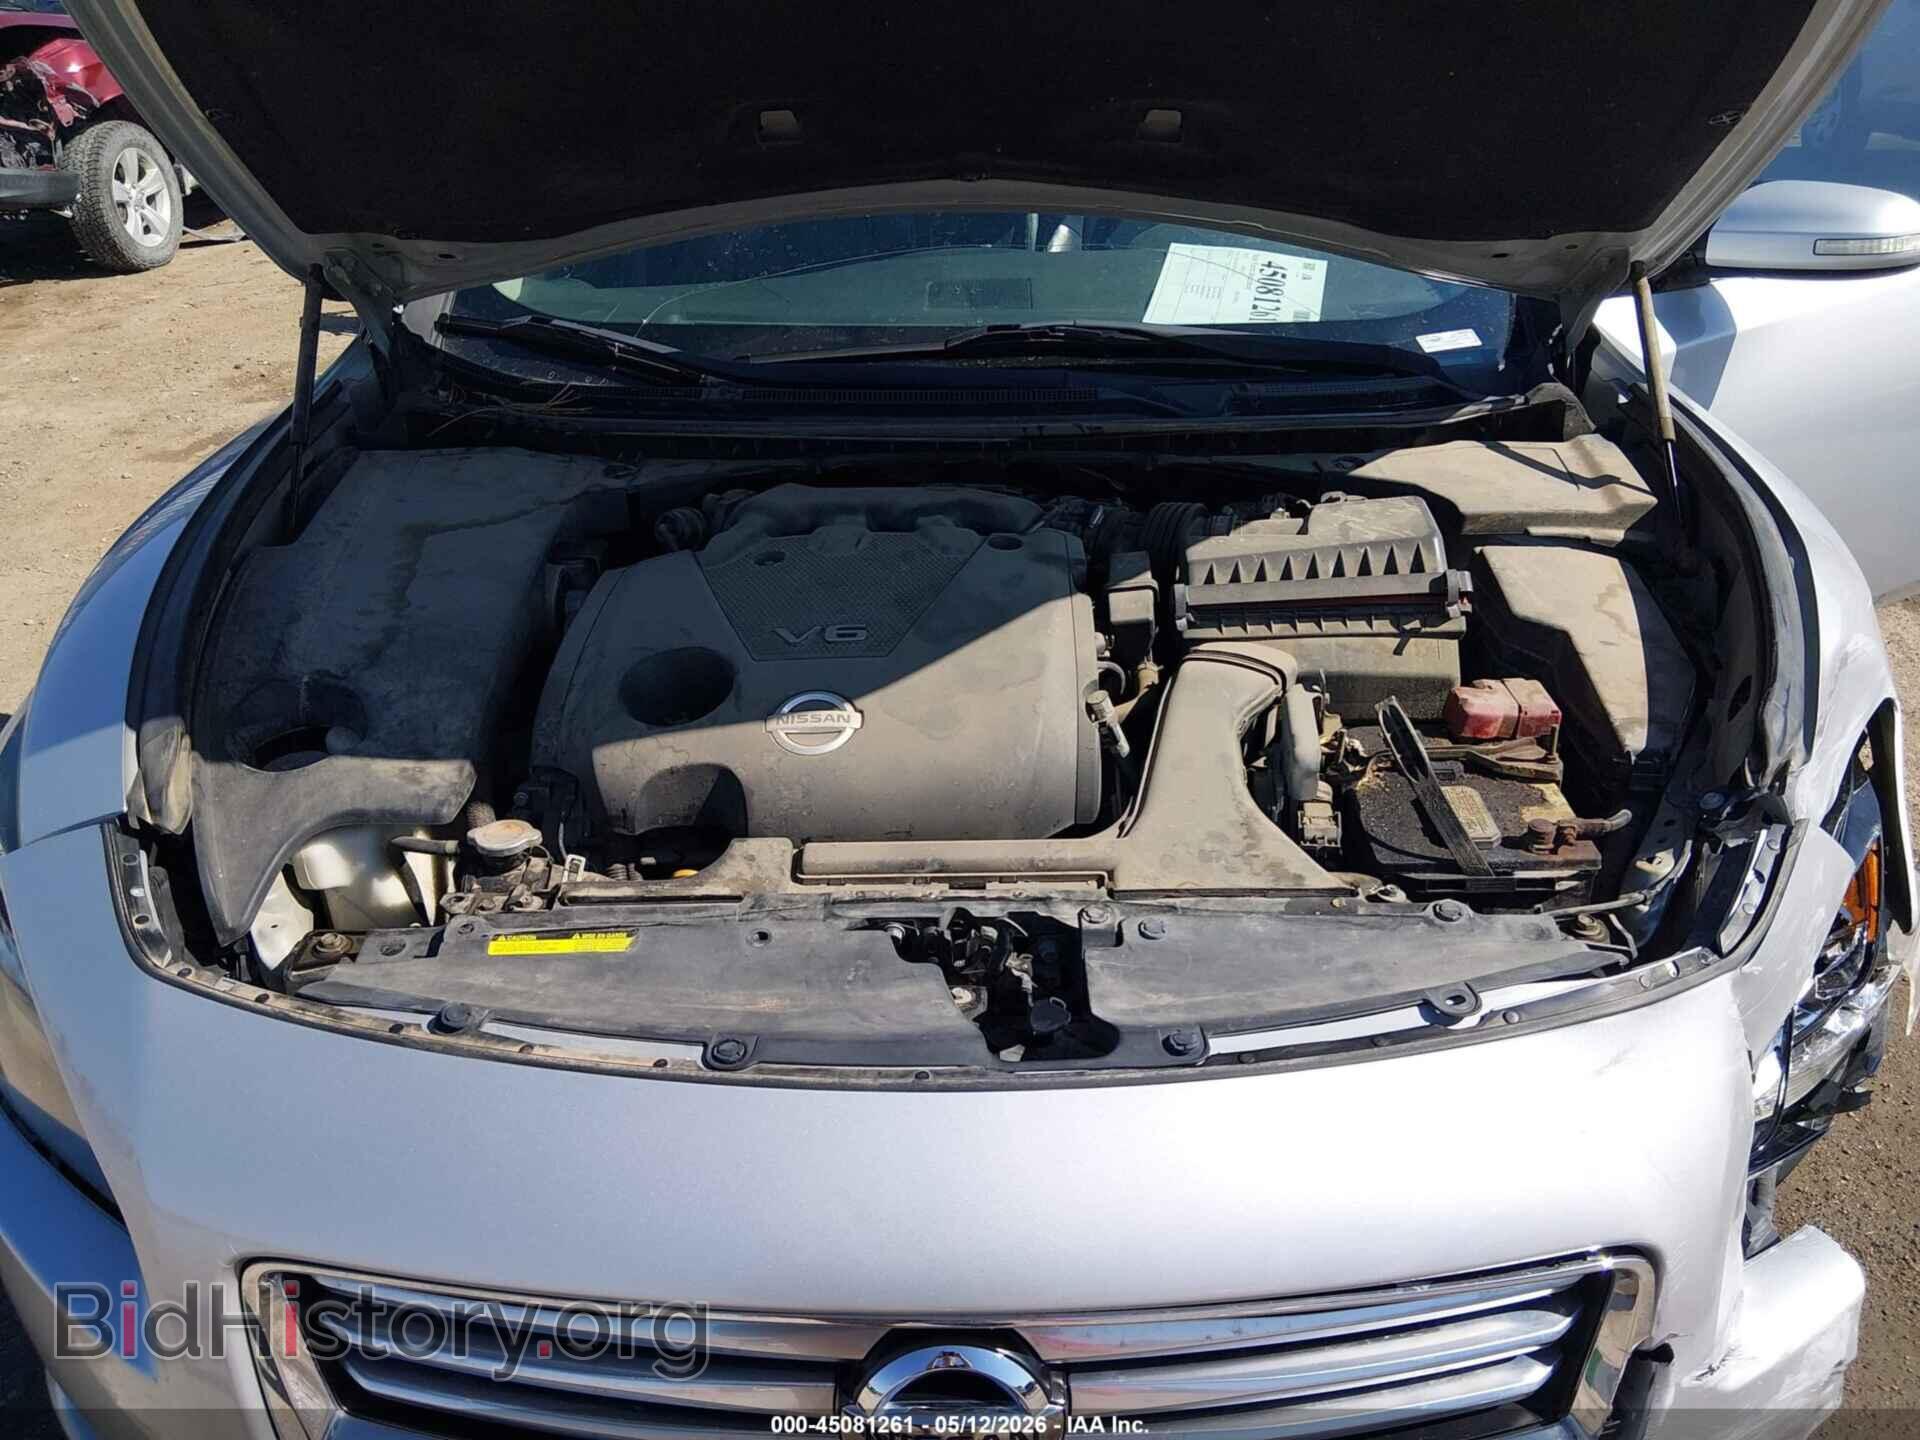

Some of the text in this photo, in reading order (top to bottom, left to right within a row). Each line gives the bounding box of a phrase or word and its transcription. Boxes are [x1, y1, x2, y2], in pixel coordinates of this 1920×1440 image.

[1249, 261, 1289, 321] 45081261
[772, 624, 867, 645] V6
[776, 713, 851, 725] NISSAN
